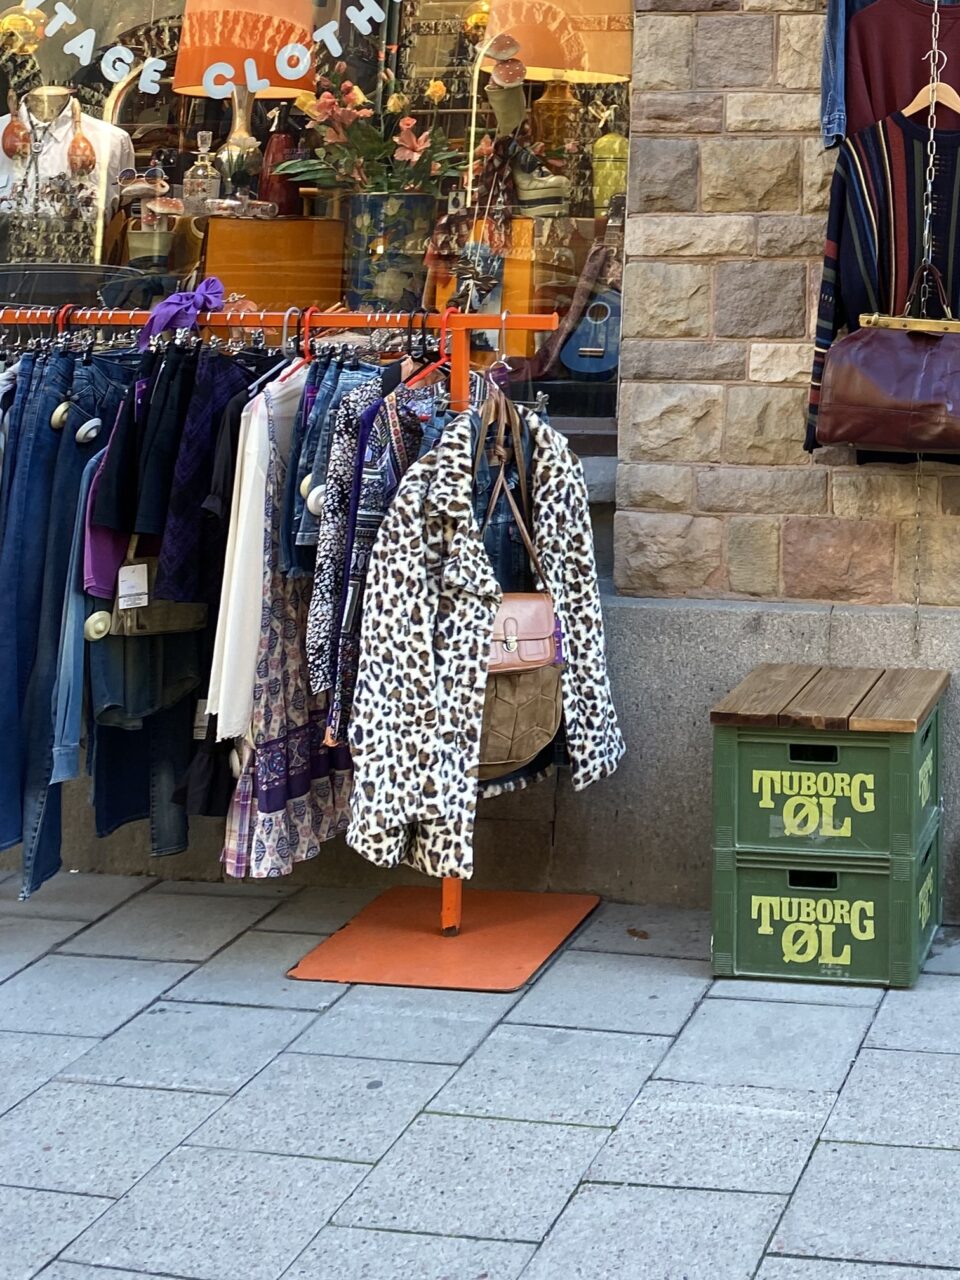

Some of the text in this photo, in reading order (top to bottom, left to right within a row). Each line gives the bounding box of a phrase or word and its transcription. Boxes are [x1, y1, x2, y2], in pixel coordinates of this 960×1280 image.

[752, 769, 876, 812] TUBORG
[782, 795, 852, 837] ØL
[751, 895, 876, 941] TUBORG
[781, 921, 852, 965] ØL
